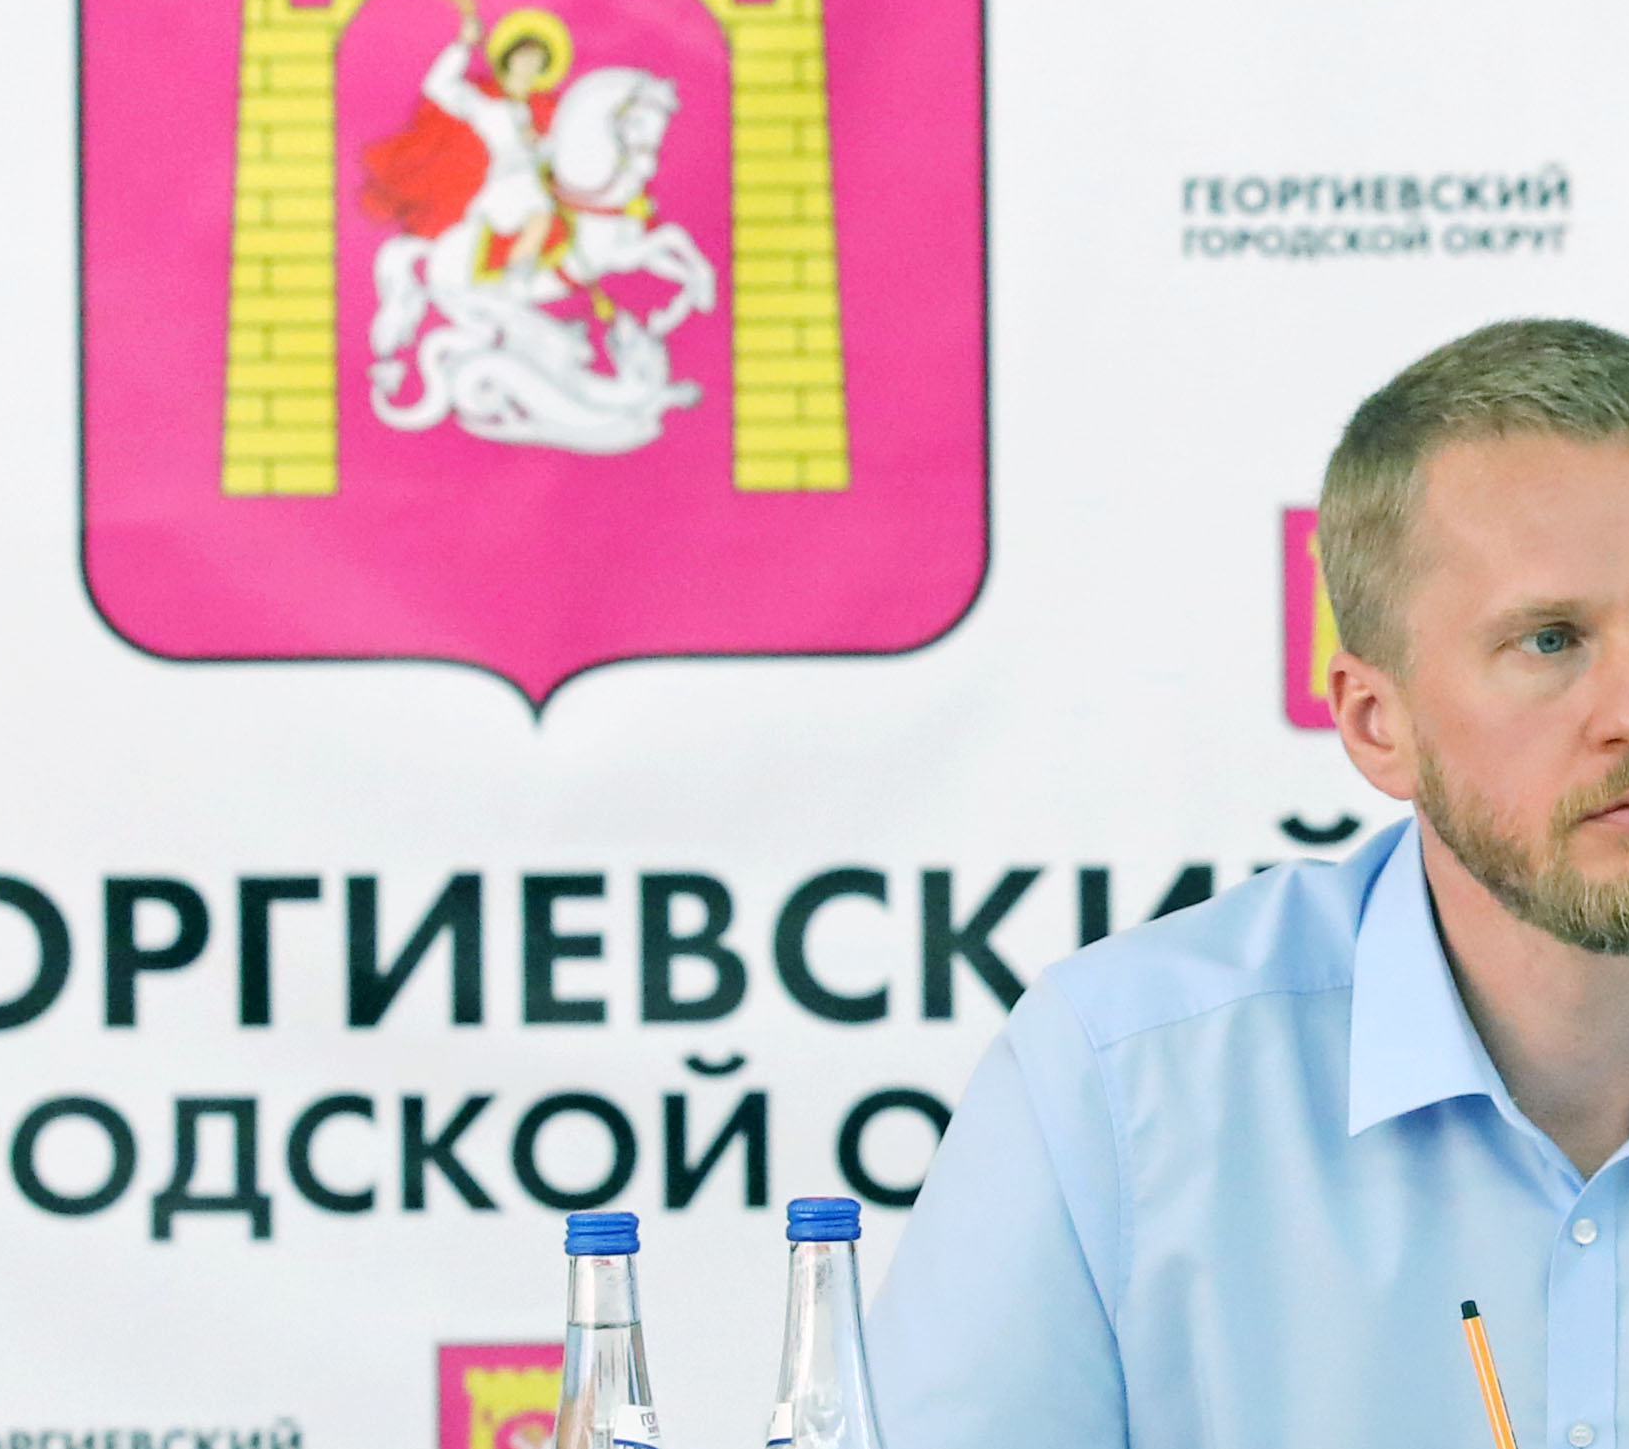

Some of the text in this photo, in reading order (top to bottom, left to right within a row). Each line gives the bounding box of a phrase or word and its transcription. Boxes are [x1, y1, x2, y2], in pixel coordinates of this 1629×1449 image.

[1182, 164, 1571, 215] ГЕОРГИЕВСКИЙ
[1183, 224, 1565, 260] ГОРОДСКОЙ ОКРУГ
